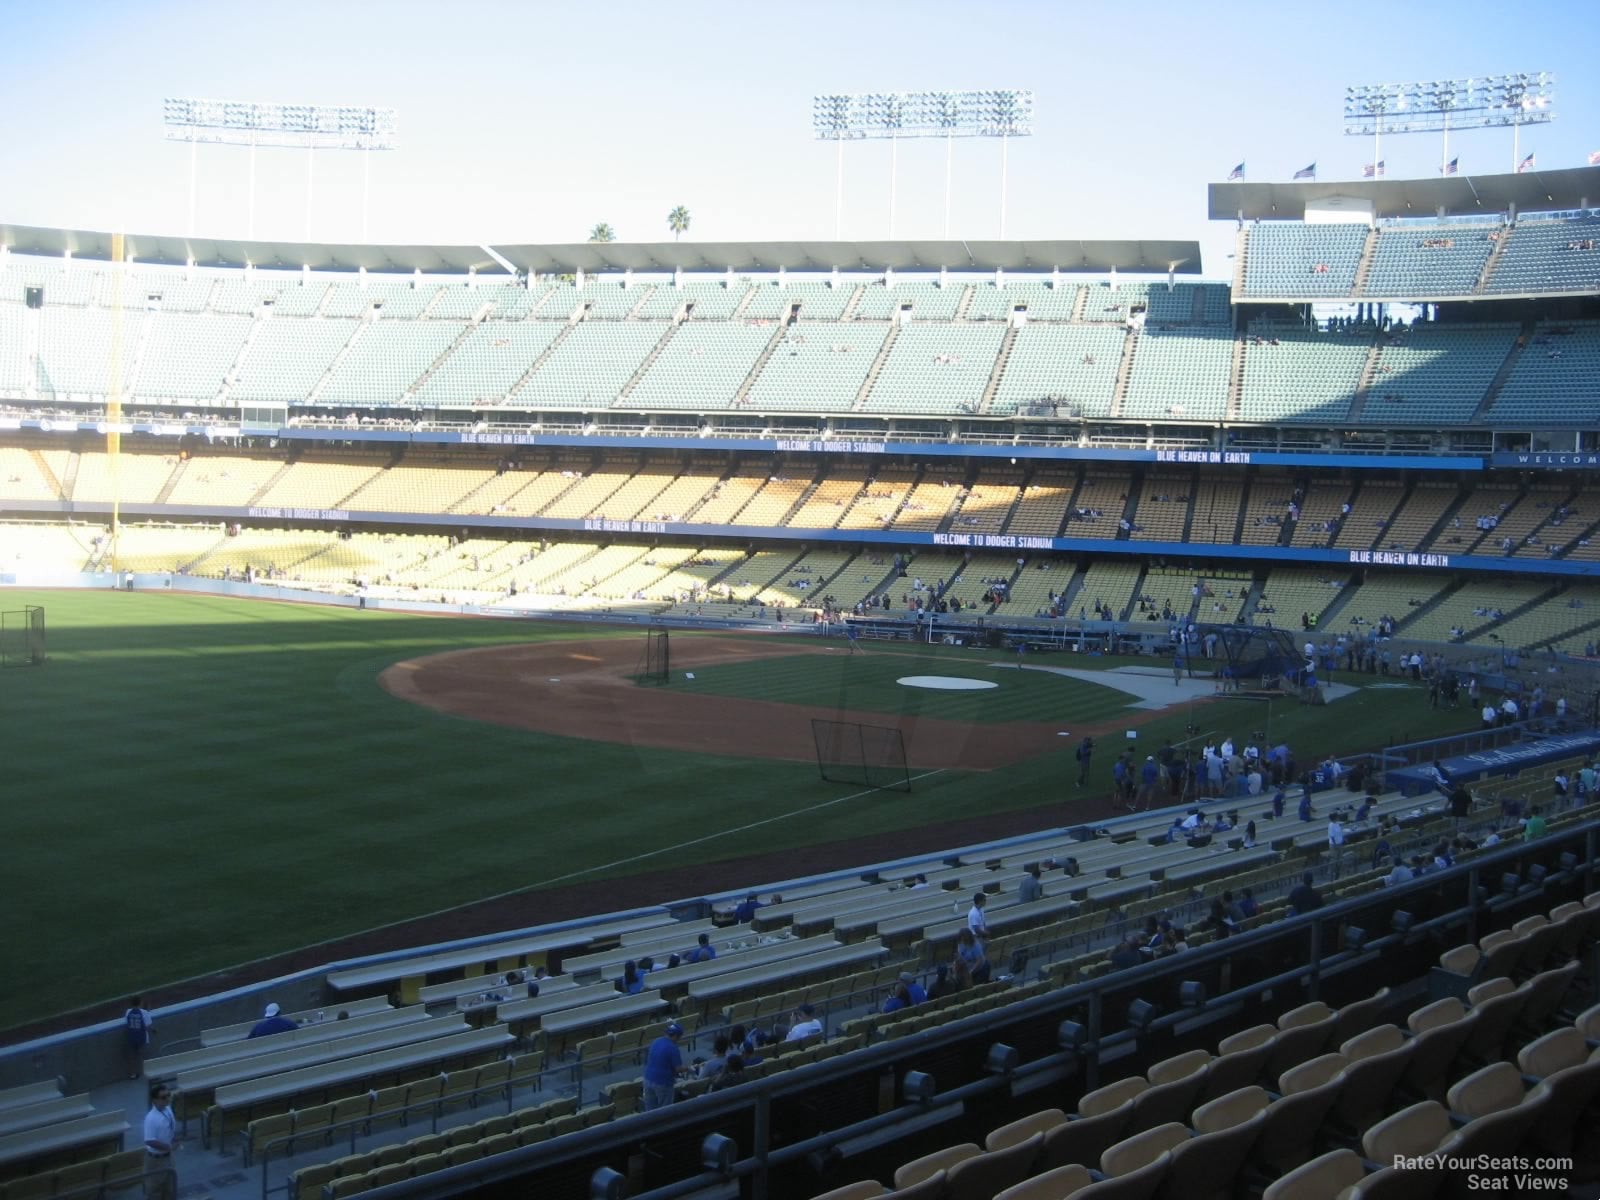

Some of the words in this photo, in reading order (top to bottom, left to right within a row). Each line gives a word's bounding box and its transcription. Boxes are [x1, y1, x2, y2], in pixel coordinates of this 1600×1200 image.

[461, 433, 477, 443] BLUE
[478, 433, 502, 444] HEAVEN
[503, 434, 513, 444] ON
[514, 434, 535, 445] EARTH
[776, 440, 810, 452] WELCOME
[813, 441, 822, 452] TO
[824, 441, 852, 453] DODGER
[854, 442, 885, 454] STADIUM
[1157, 450, 1176, 462] BLUE
[1178, 450, 1208, 463] HEAVEN
[1209, 451, 1221, 463] ON
[1225, 452, 1250, 464] EARTH
[249, 507, 280, 518] WELCOME
[283, 508, 292, 518] TO
[294, 508, 319, 519] DODGER
[321, 509, 350, 520] STADIUM
[585, 520, 602, 531] BLUE
[603, 520, 630, 532] HEAVEN
[643, 522, 666, 534] EARTH
[933, 533, 970, 545] WELCOME
[974, 534, 983, 546] TO
[985, 535, 1016, 547] DODGER
[1018, 537, 1053, 549] STADIUM
[1350, 551, 1370, 563] BLUE
[1373, 552, 1404, 565] HEAVEN
[1407, 553, 1419, 565] ON
[1421, 554, 1448, 567] EARTH
